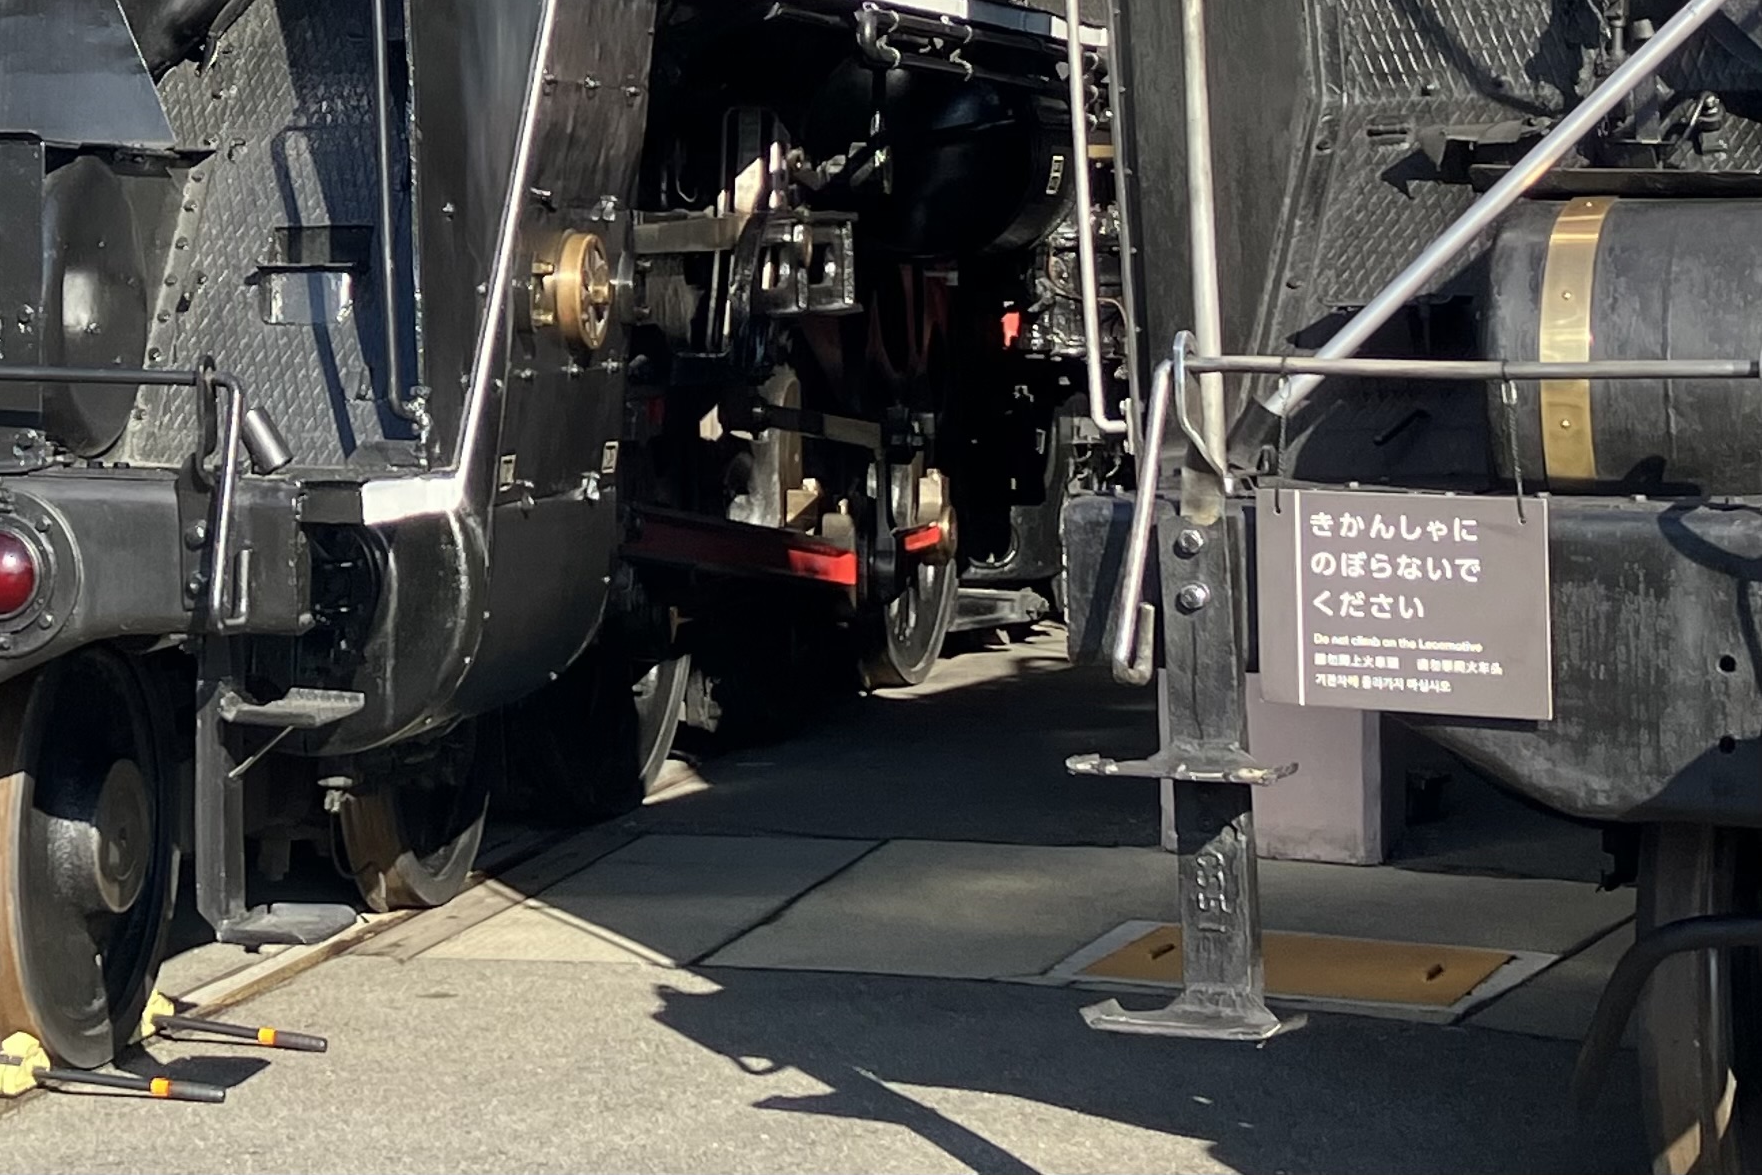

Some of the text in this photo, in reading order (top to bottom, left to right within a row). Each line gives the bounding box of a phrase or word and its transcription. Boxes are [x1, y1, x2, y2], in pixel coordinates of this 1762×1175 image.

[1309, 511, 1479, 543] きかんしゃに
[1309, 551, 1482, 583] のぼらないで
[1312, 590, 1425, 619] ください
[1313, 632, 1330, 645] Do
[1331, 635, 1350, 646] not
[1381, 638, 1398, 648] on
[1398, 638, 1417, 650] the
